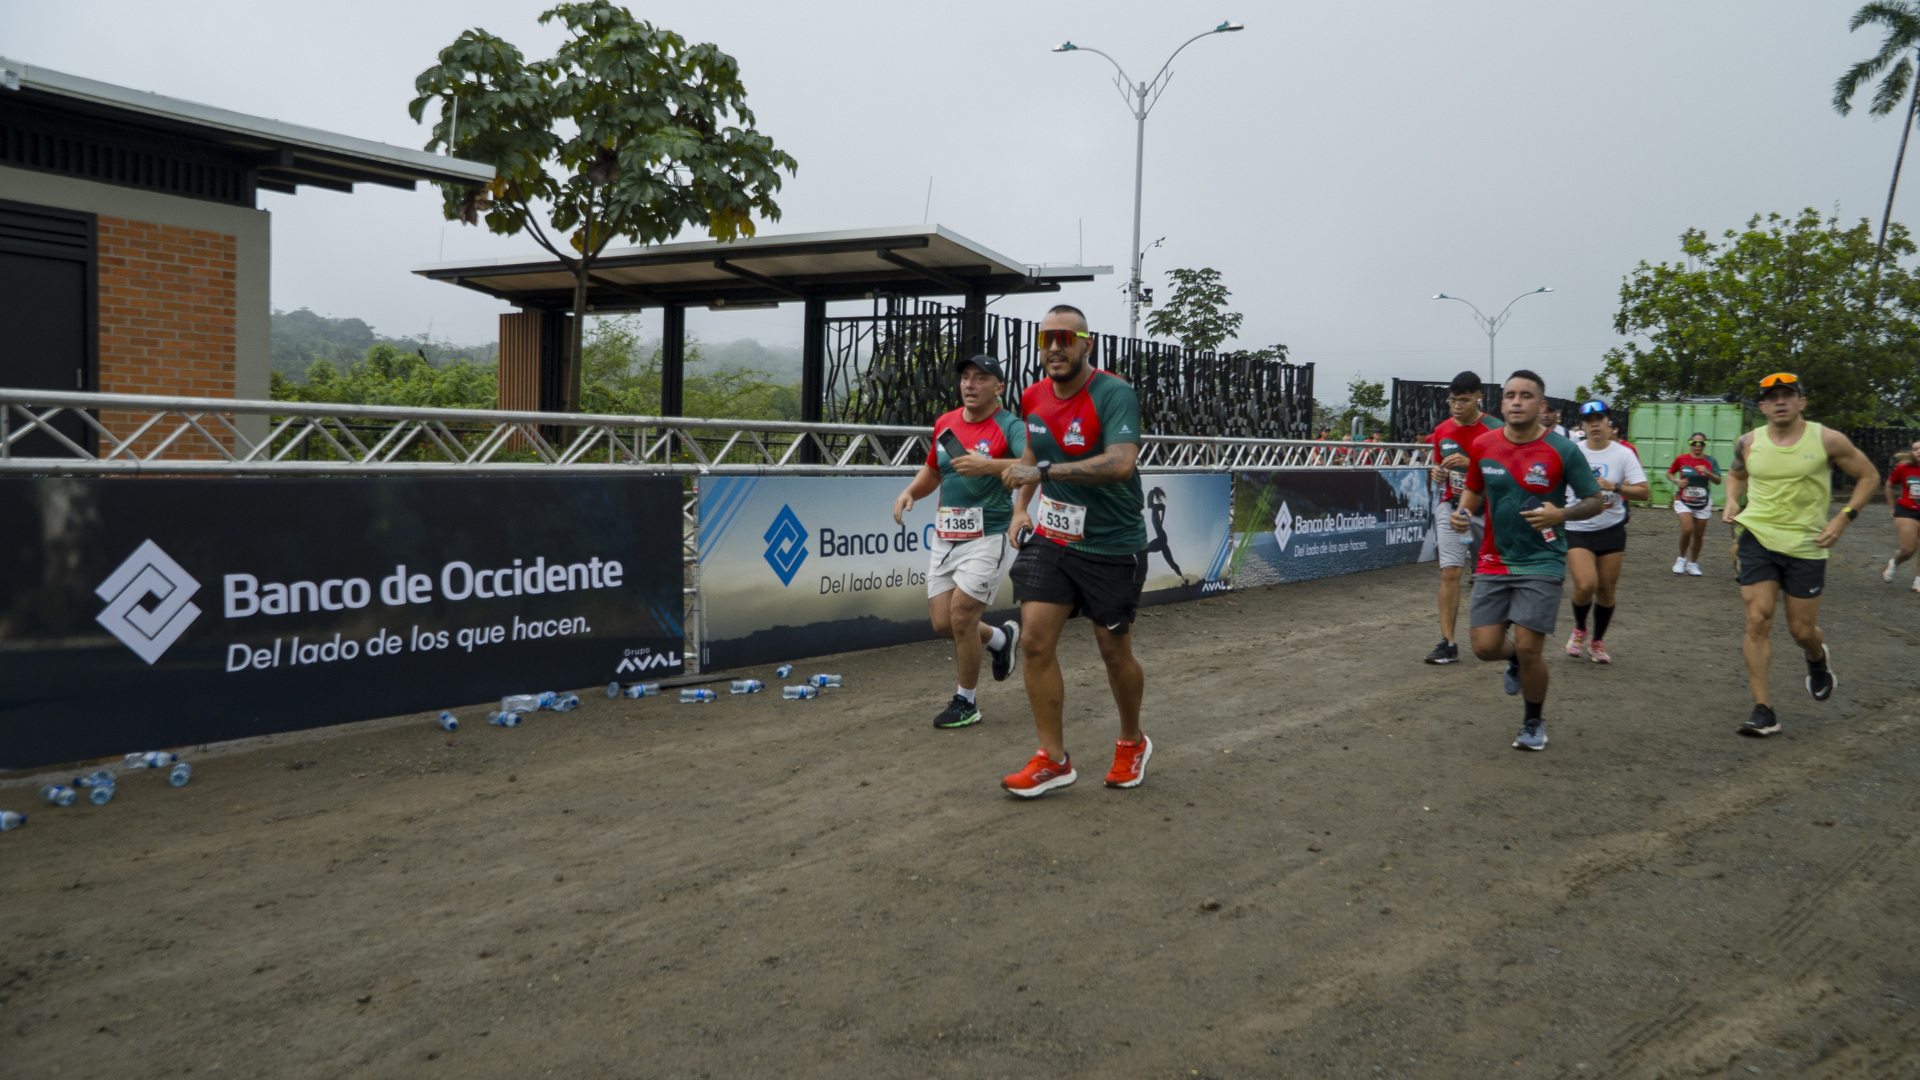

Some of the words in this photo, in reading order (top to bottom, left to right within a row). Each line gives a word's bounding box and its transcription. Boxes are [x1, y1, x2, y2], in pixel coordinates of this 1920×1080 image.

[945, 518, 975, 530] 1385
[1046, 512, 1069, 530] 533
[1295, 515, 1322, 534] Banco
[1323, 514, 1335, 532] de
[1336, 512, 1377, 530] Occidente
[1385, 508, 1396, 524] TU
[820, 528, 889, 557] Banco
[894, 525, 918, 552] de
[1294, 545, 1305, 557] Del
[1320, 541, 1328, 554] de
[1328, 541, 1338, 553] los
[223, 573, 371, 618] Banco
[380, 565, 433, 606] de
[441, 557, 623, 600] Occidente
[820, 573, 845, 595] Del
[849, 571, 882, 592] lado
[886, 568, 903, 588] de
[907, 567, 926, 586] los
[1202, 580, 1226, 592] AVAL
[226, 638, 282, 673] Del
[290, 633, 360, 666] lado
[366, 628, 403, 657] de
[411, 624, 450, 652] los
[457, 625, 505, 653] que
[511, 616, 592, 641] hacen.
[624, 648, 650, 656] Grupo
[615, 651, 682, 674] AVAL
